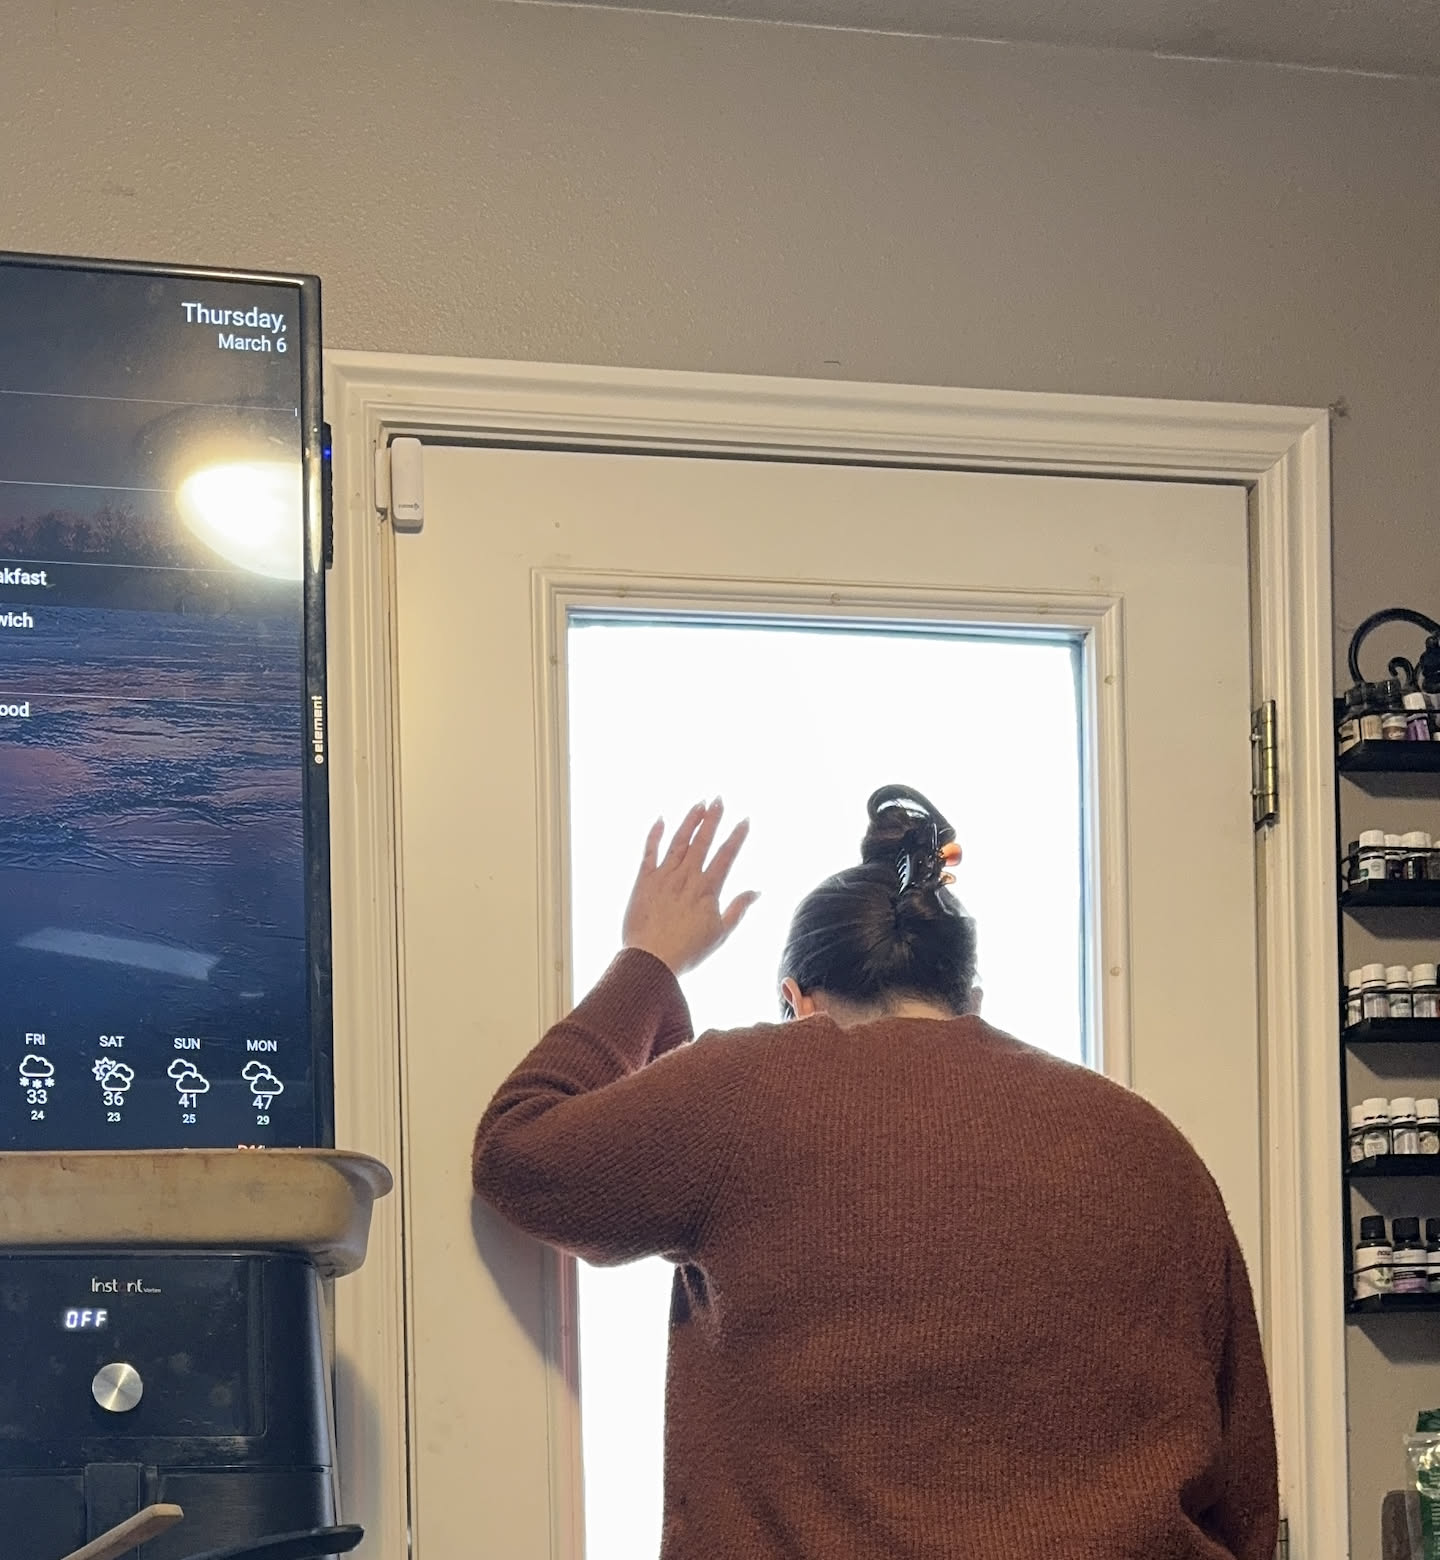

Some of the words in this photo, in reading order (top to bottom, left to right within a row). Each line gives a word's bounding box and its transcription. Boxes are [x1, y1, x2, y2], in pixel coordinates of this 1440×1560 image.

[181, 302, 287, 334] Thursday,
[218, 333, 272, 352] March
[276, 337, 287, 353] 6
[311, 695, 324, 753] element
[25, 1033, 46, 1046] FRI
[99, 1035, 125, 1048] SAT
[173, 1038, 201, 1050] SUN
[246, 1039, 278, 1052] MON
[26, 1089, 48, 1105] 33
[103, 1091, 124, 1106] 36
[178, 1093, 197, 1108] 41
[252, 1095, 273, 1110] 47
[30, 1110, 45, 1121] 24
[107, 1112, 121, 1122] 23
[182, 1113, 196, 1124] 25
[256, 1115, 270, 1126] 29
[66, 1310, 107, 1328] OFF
